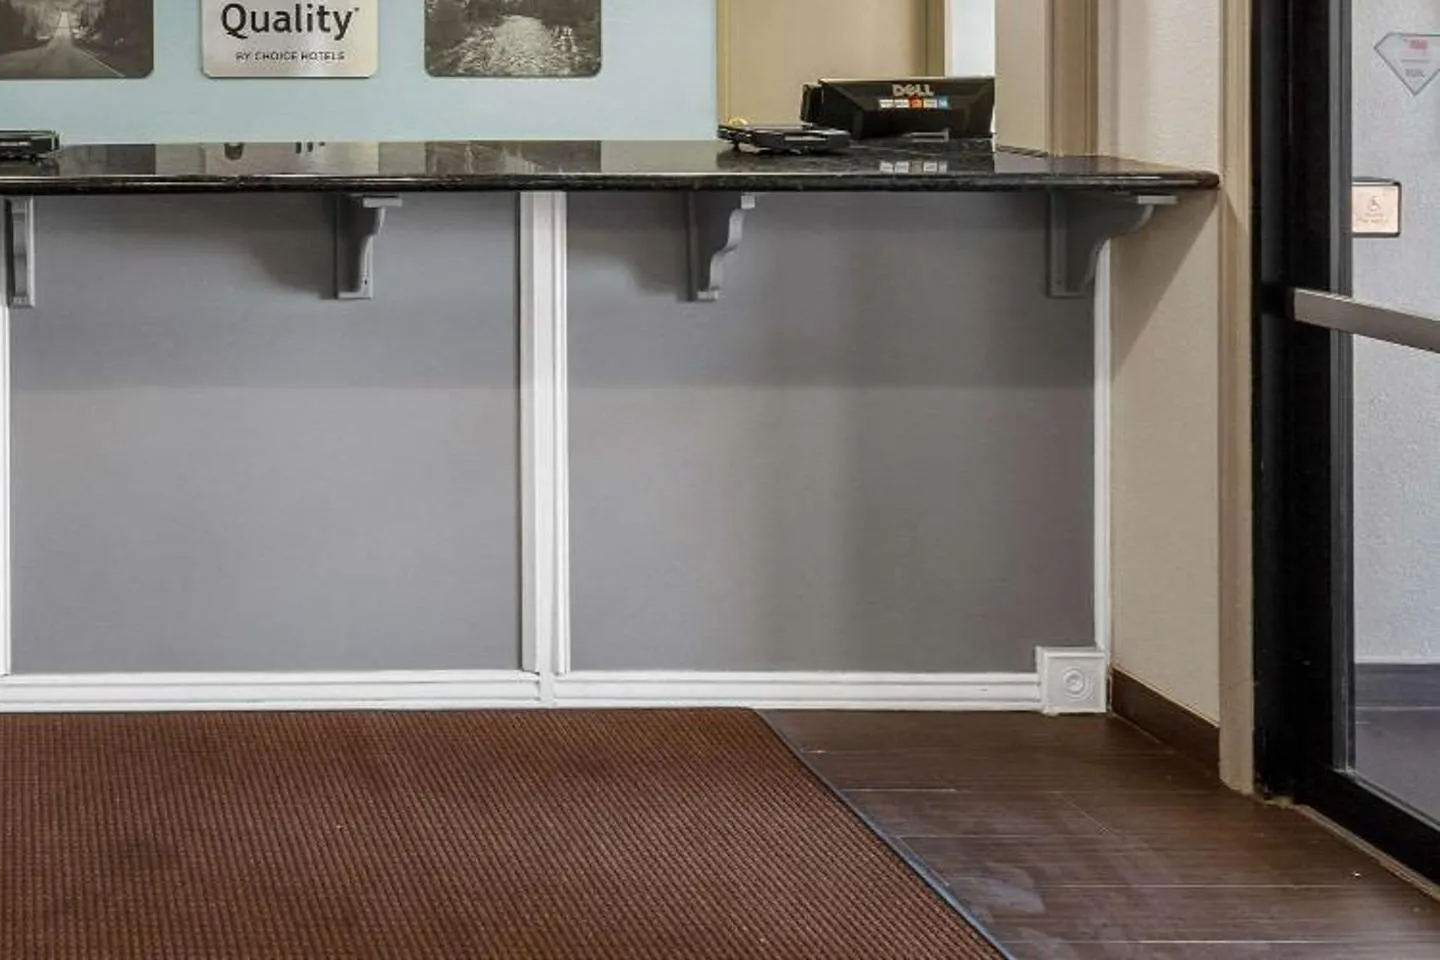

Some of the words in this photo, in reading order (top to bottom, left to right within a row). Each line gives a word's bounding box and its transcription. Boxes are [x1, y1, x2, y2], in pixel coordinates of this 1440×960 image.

[221, 3, 354, 41] Quality
[236, 51, 251, 61] BY
[254, 51, 298, 61] CHOICE
[301, 51, 345, 61] HOTELS
[891, 83, 935, 97] DELL
